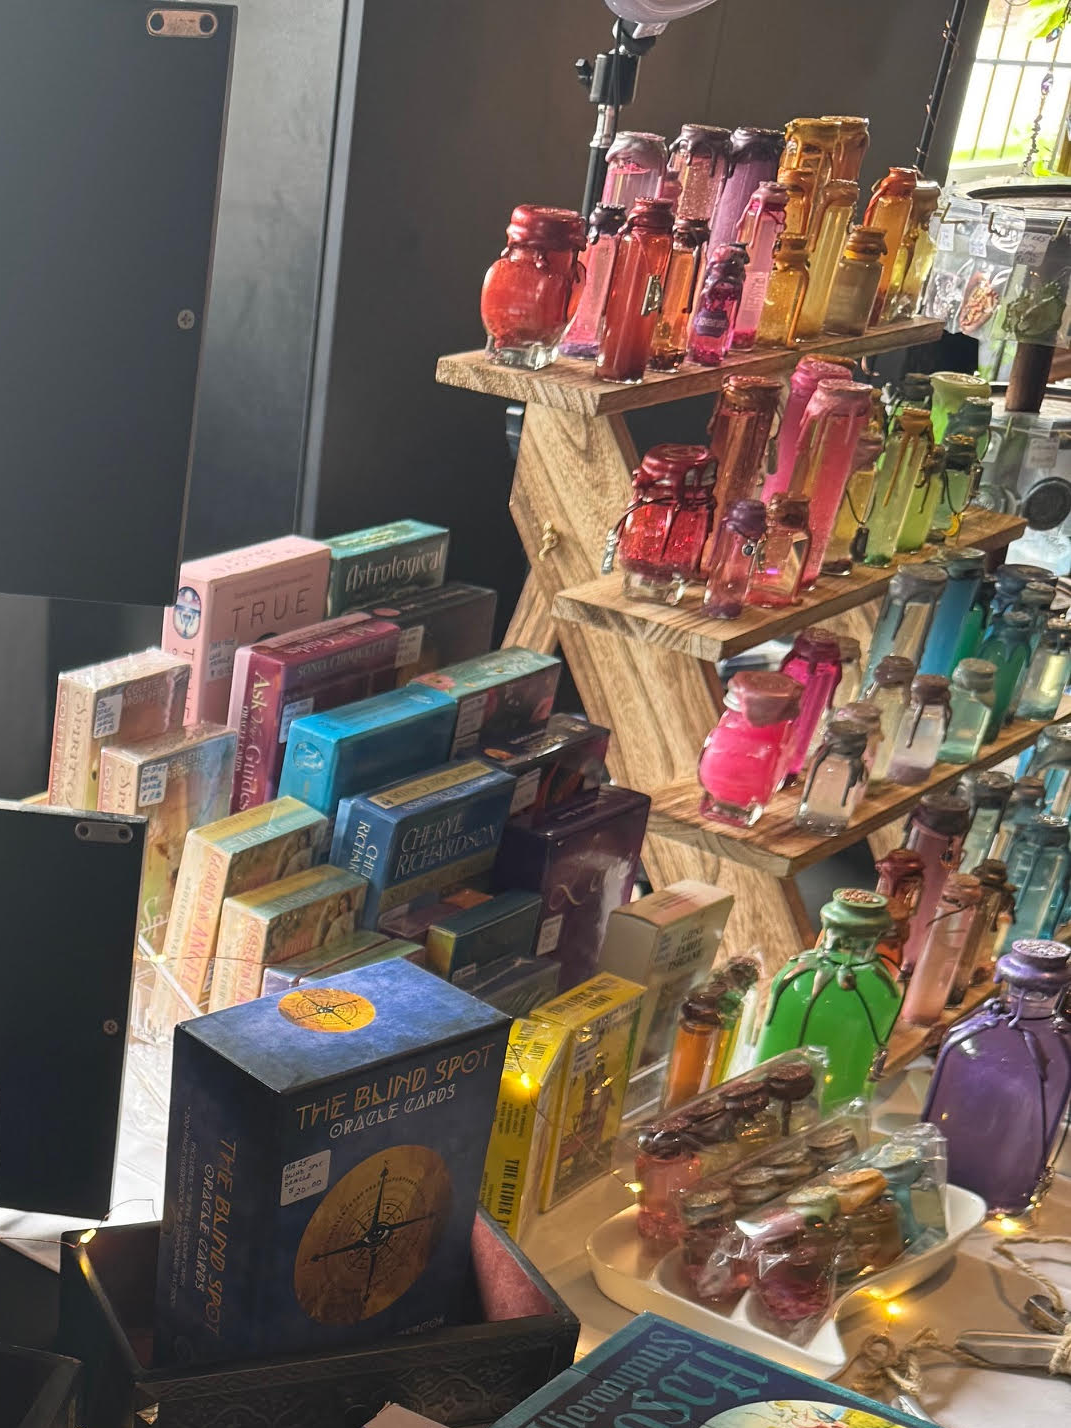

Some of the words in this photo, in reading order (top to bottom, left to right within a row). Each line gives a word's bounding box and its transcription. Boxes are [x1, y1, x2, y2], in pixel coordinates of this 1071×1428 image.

[345, 543, 444, 592] Astrological
[231, 586, 312, 633] TRUE
[249, 671, 272, 710] Ask
[239, 743, 262, 812] Guides
[348, 820, 371, 873] RICHAR
[394, 823, 496, 880] RICHARDSON
[401, 812, 464, 854] CHERYL
[296, 1092, 349, 1131] THE
[353, 1066, 428, 1113] BLIND
[432, 1043, 496, 1085] SPOT
[329, 1101, 400, 1139] ORACLE
[403, 1083, 457, 1114] CARDS
[216, 1138, 237, 1192] THE
[198, 1163, 215, 1234] ORACLE
[208, 1194, 231, 1272] BLIND
[194, 1238, 209, 1293] CARDS
